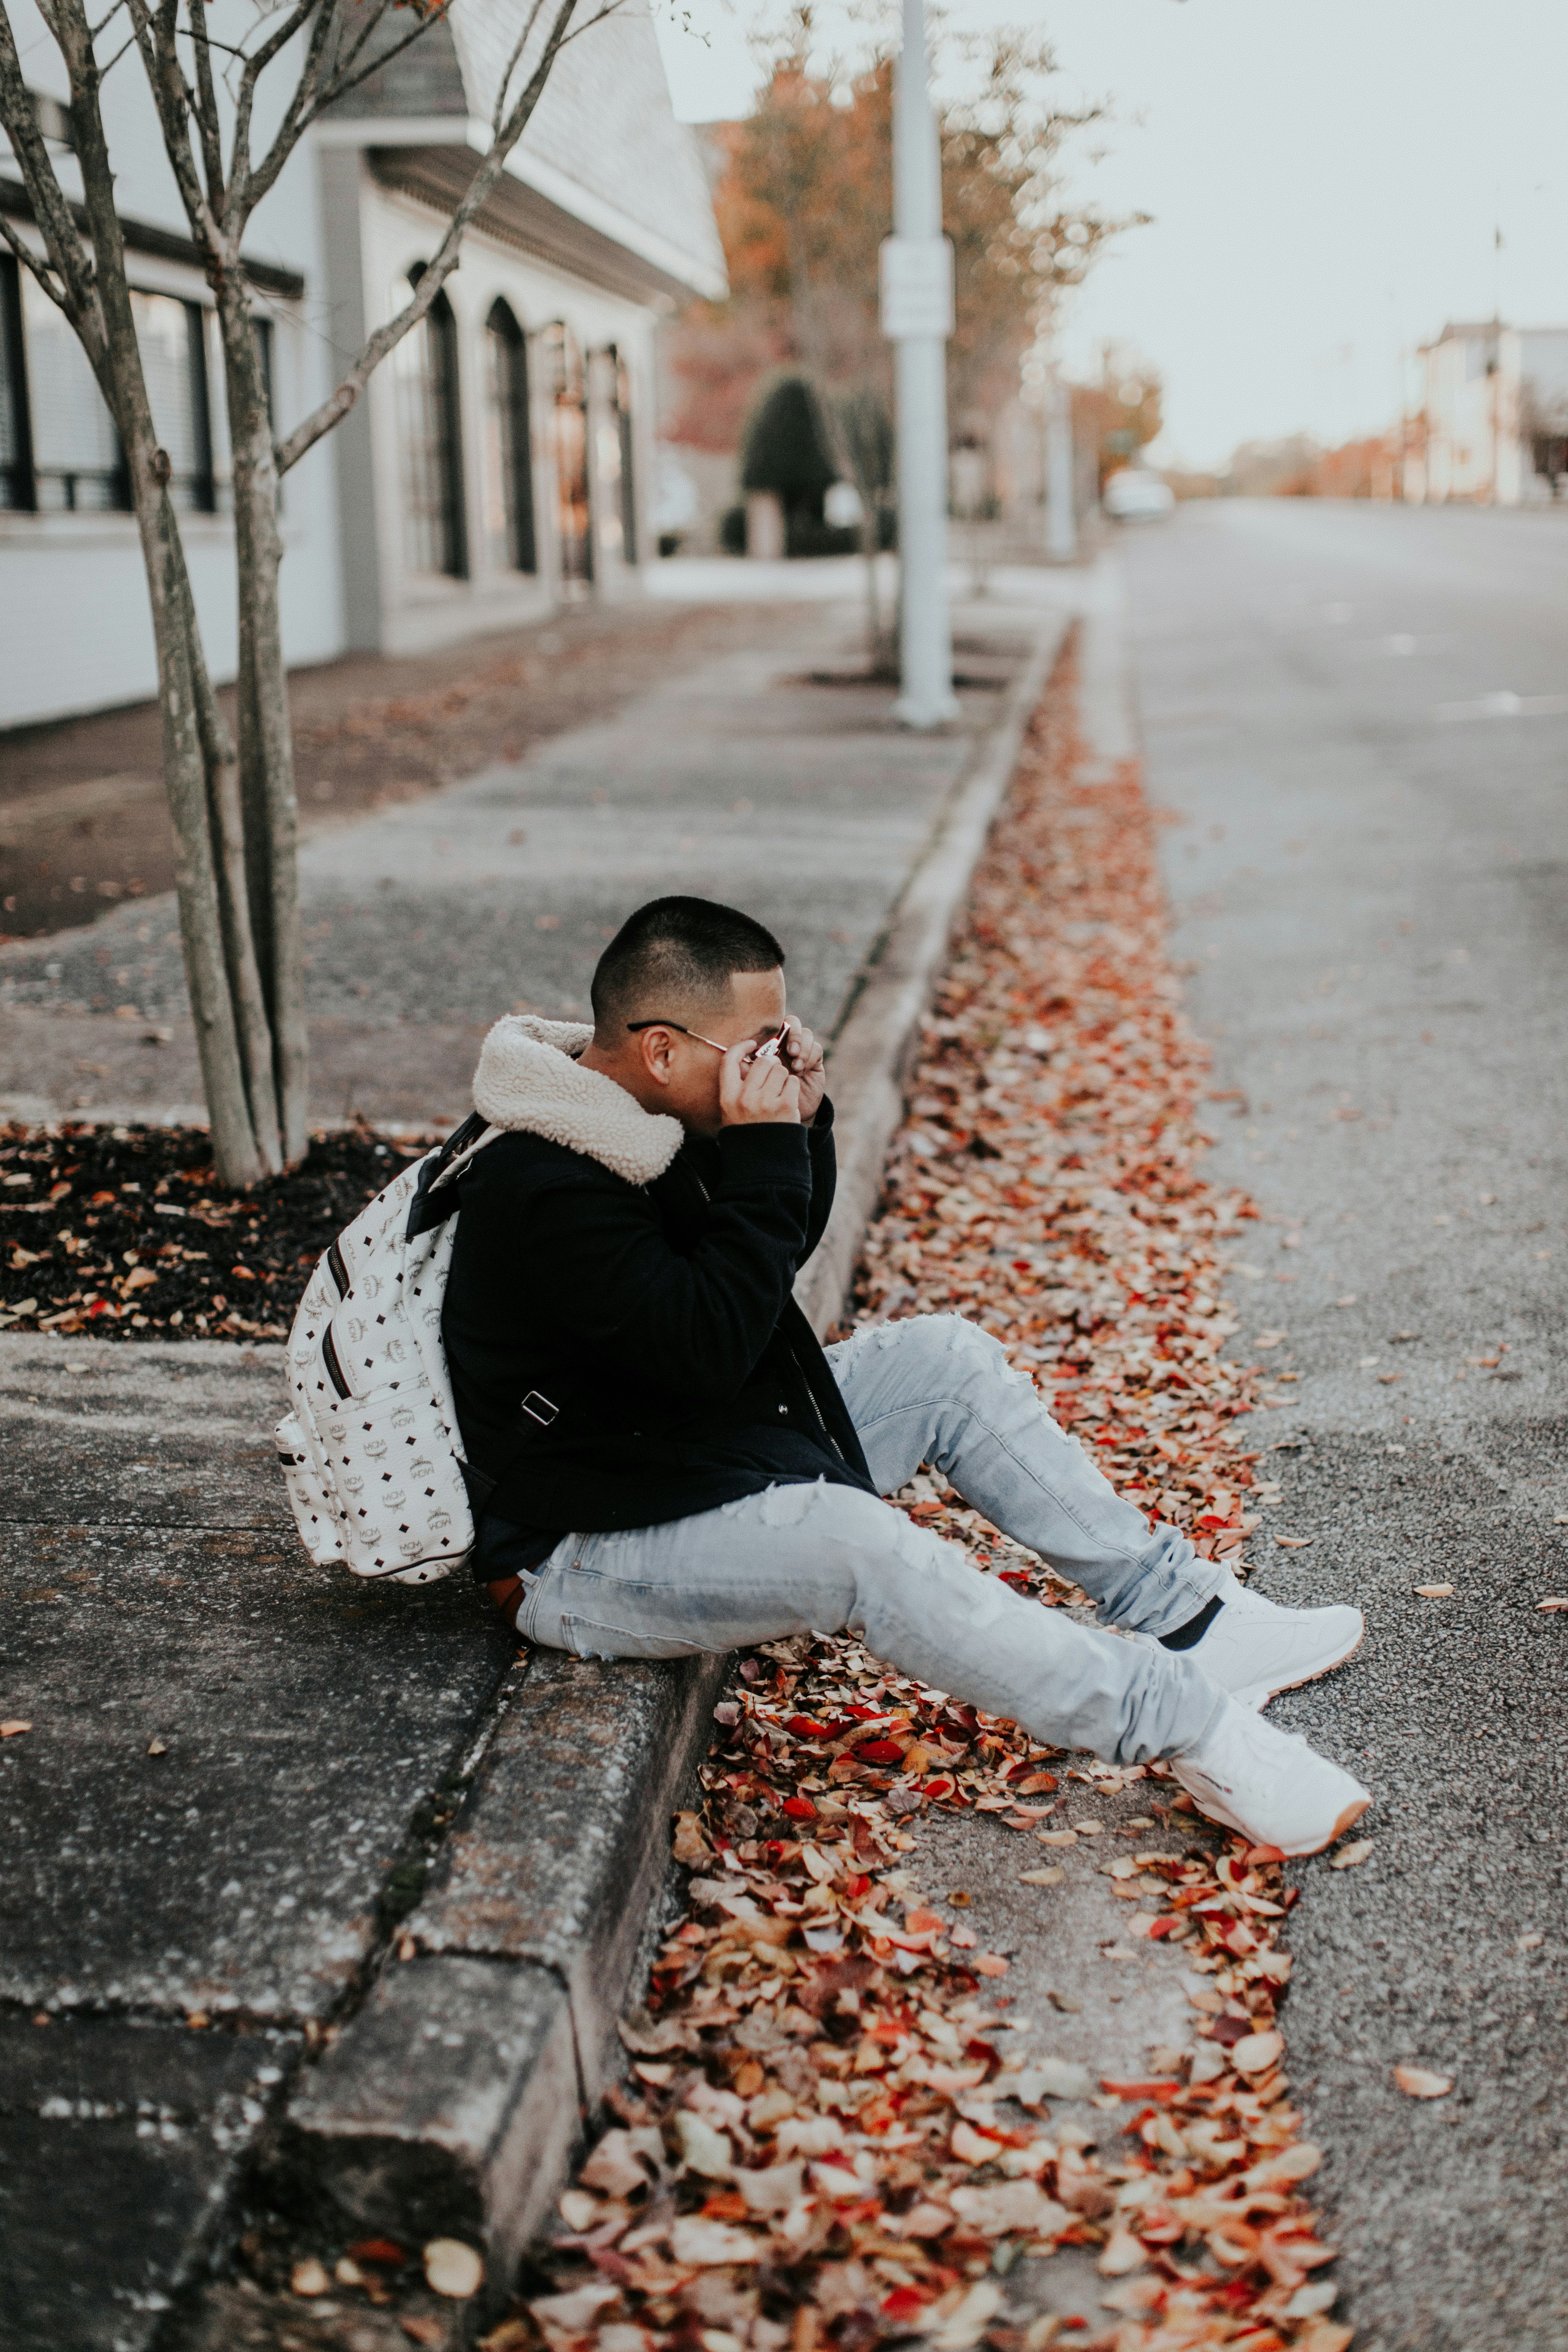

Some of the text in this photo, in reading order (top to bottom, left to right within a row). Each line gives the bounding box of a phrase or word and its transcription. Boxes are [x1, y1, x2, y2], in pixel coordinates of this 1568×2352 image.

[392, 1339, 407, 1363] MCM
[391, 1414, 415, 1429] MCM
[364, 1439, 386, 1452] MCM
[411, 1466, 434, 1479] MCM
[344, 1475, 364, 1487] MCM
[382, 1489, 407, 1504] MCM
[428, 1517, 452, 1531] MCM
[359, 1526, 381, 1540] MCM
[399, 1540, 422, 1553] MCM
